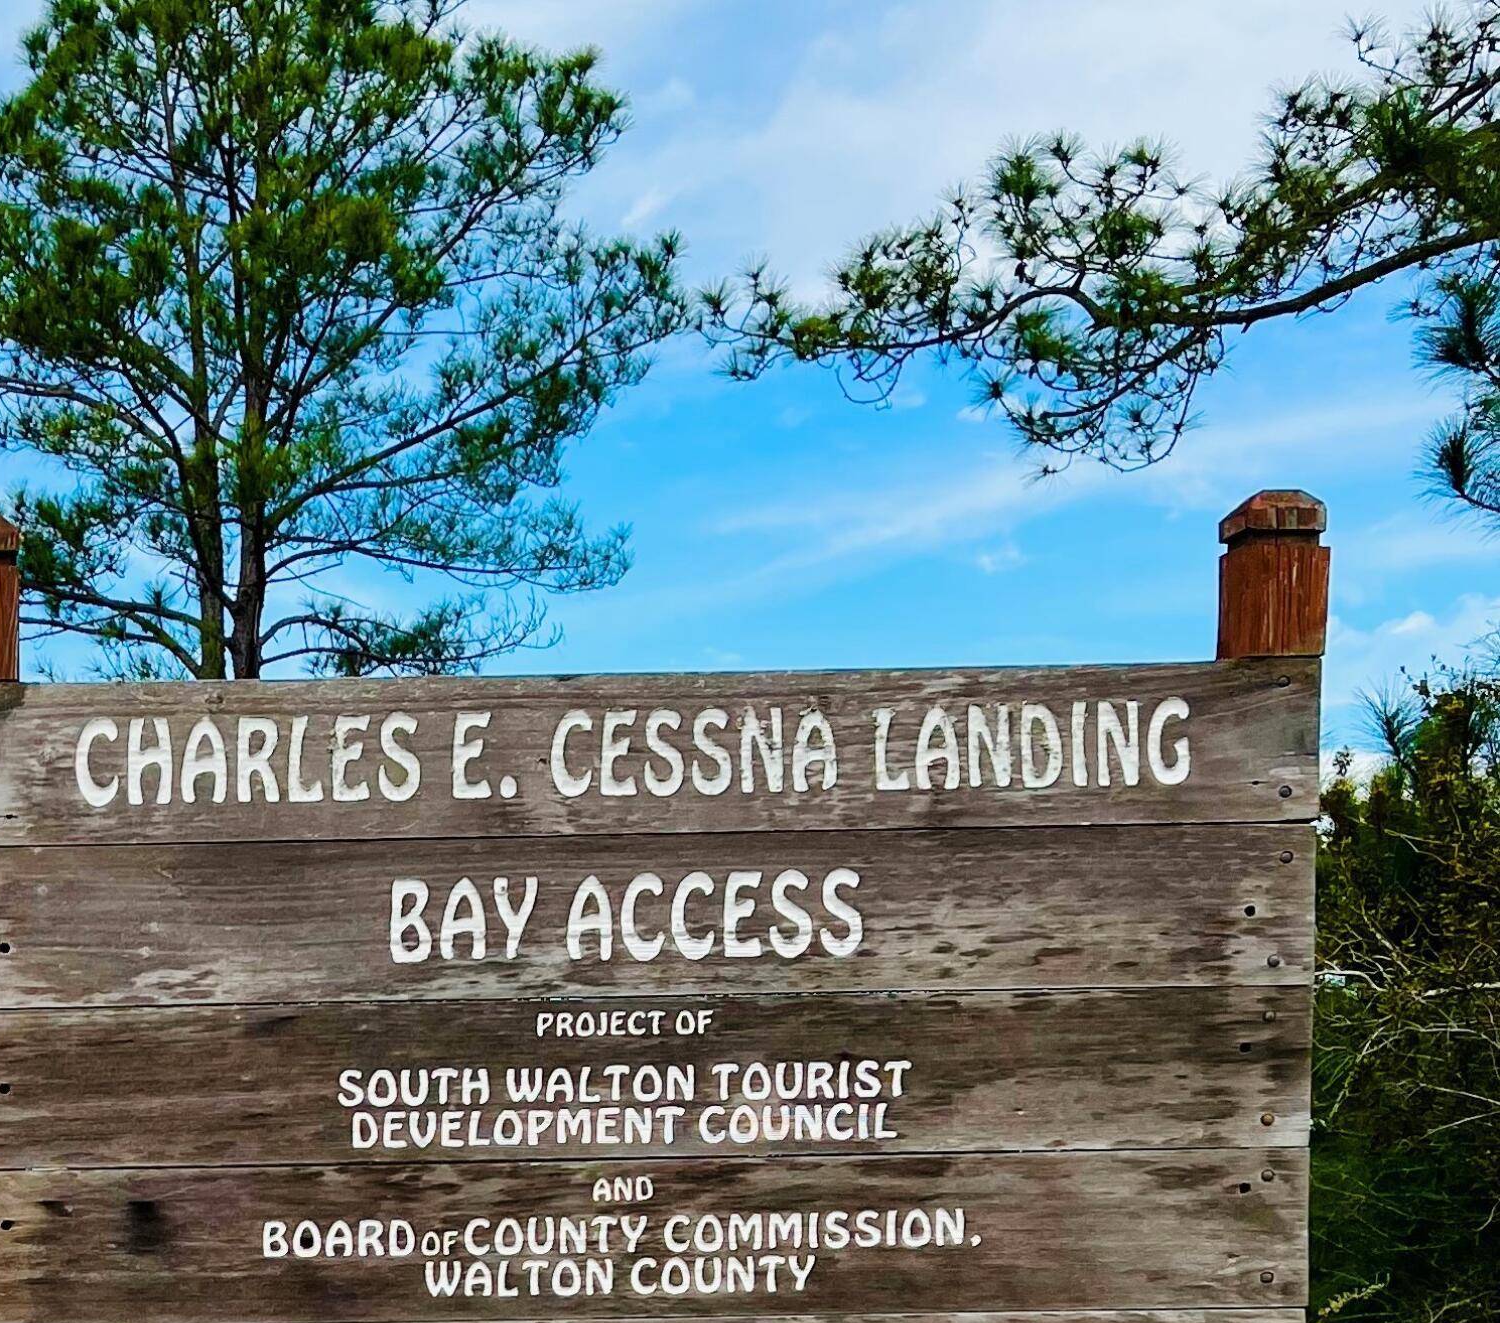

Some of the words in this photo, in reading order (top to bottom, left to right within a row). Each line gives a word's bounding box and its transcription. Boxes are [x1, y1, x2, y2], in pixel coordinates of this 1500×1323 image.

[75, 715, 421, 807] CHARLES
[452, 711, 517, 799] E.
[550, 707, 838, 797] CESSNA
[875, 700, 1191, 790] LANDING
[389, 876, 538, 964] BAY
[566, 869, 863, 962] ACCESS
[536, 1011, 666, 1037] PROJECT
[675, 1010, 714, 1035] OF
[338, 1068, 490, 1107] SOUTH
[506, 1064, 695, 1103] WALTON
[711, 1060, 912, 1101] TOURIST
[352, 1106, 686, 1149] DEVELOPMENT
[698, 1102, 897, 1144] COUNCIL
[592, 1176, 653, 1202] AND
[262, 1219, 416, 1258] BOARD
[421, 1230, 459, 1256] OF
[464, 1215, 648, 1256] COUNTY
[425, 1258, 613, 1297] WALTON
[630, 1255, 816, 1295] COUNTY
